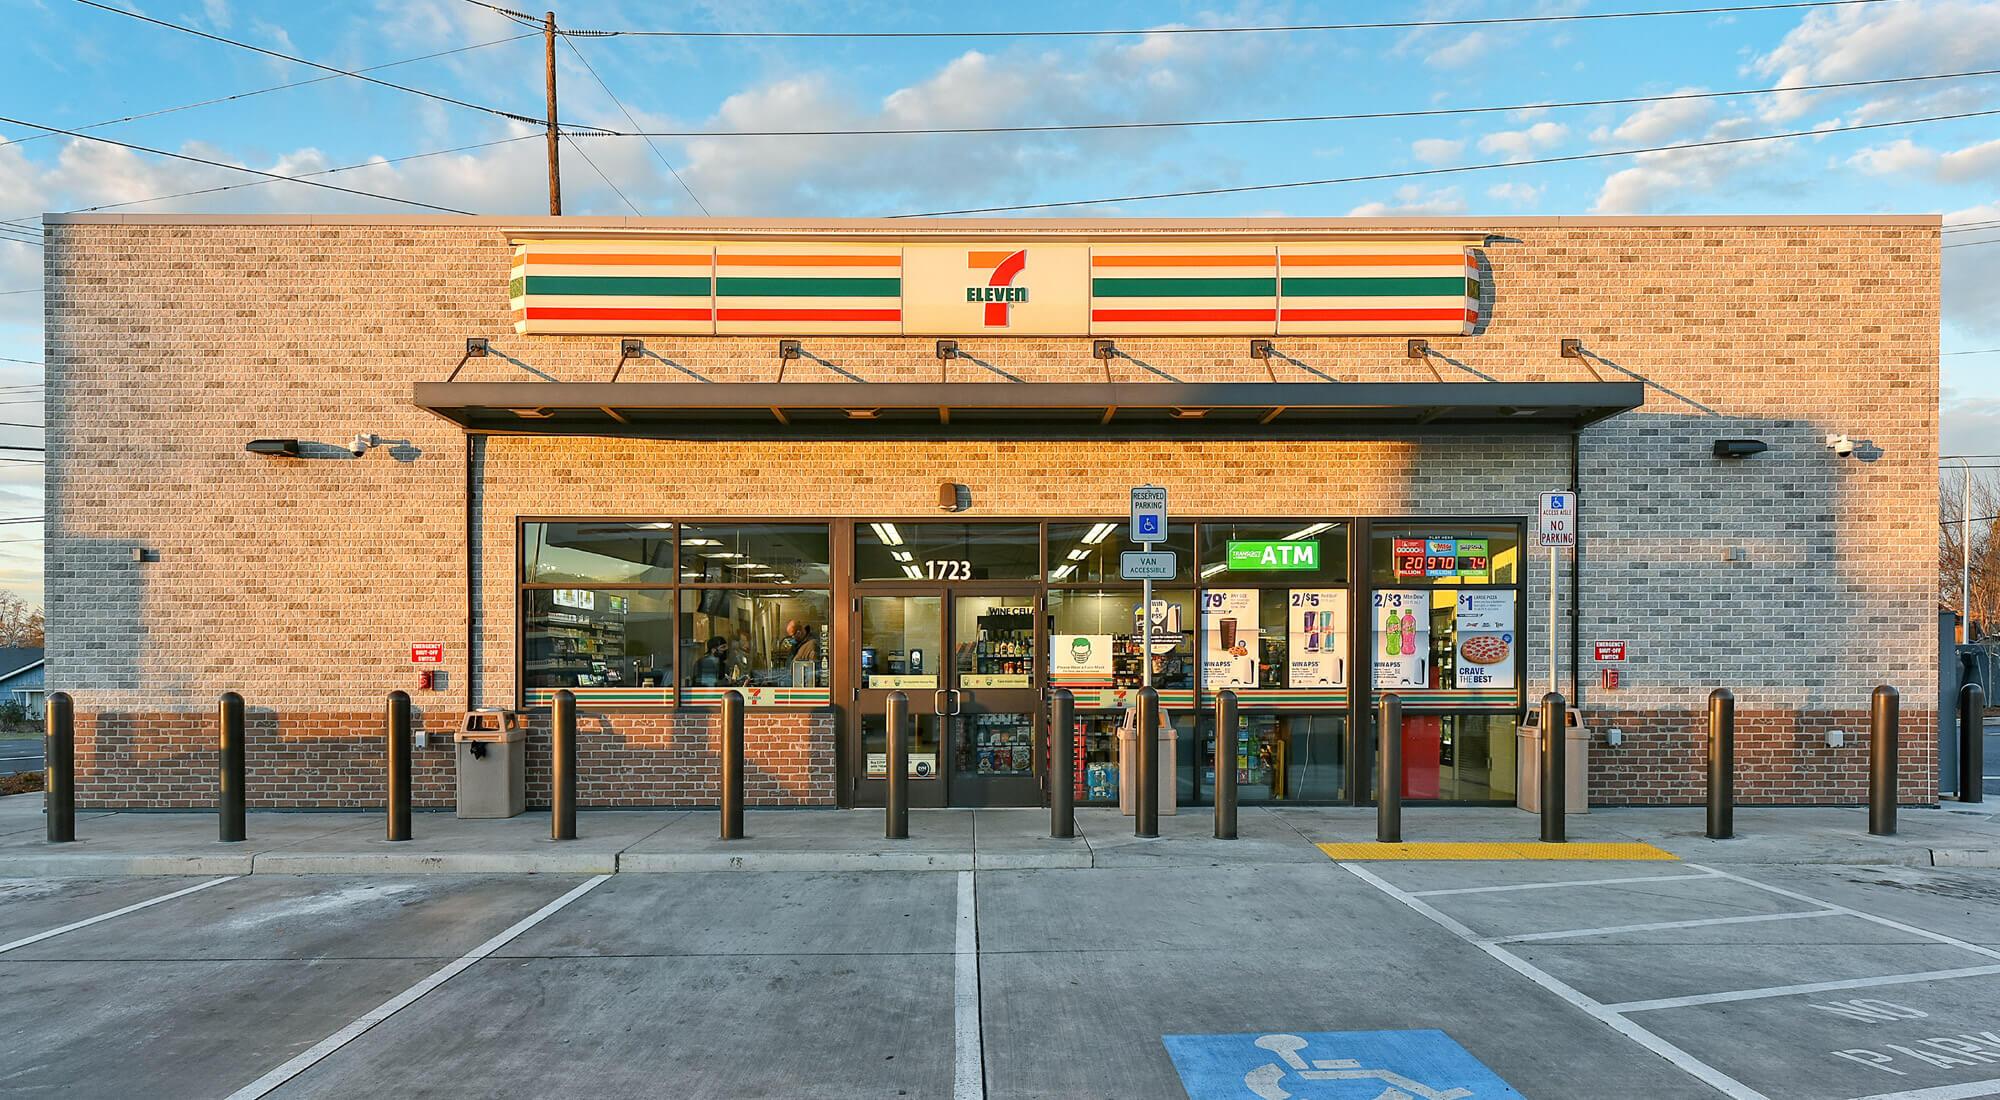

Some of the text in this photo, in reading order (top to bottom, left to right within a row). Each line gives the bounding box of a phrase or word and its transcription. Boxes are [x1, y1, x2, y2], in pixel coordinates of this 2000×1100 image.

[967, 249, 1025, 326] 7
[1133, 492, 1164, 500] RESERVED
[1550, 520, 1564, 531] NO
[1541, 533, 1573, 543] PARKING
[1260, 545, 1314, 565] ATM
[925, 560, 971, 580] 1723
[1405, 557, 1423, 569] 20
[1427, 557, 1455, 569] 970
[1204, 592, 1228, 608] 79¢
[1292, 592, 1319, 608] 2/$5
[1374, 593, 1402, 608] 2/$3
[1459, 594, 1473, 610] $1
[988, 607, 1011, 616] WINE
[1459, 667, 1485, 675] CRAVE
[748, 688, 761, 705] 7
[1808, 999, 1929, 1023] NO
